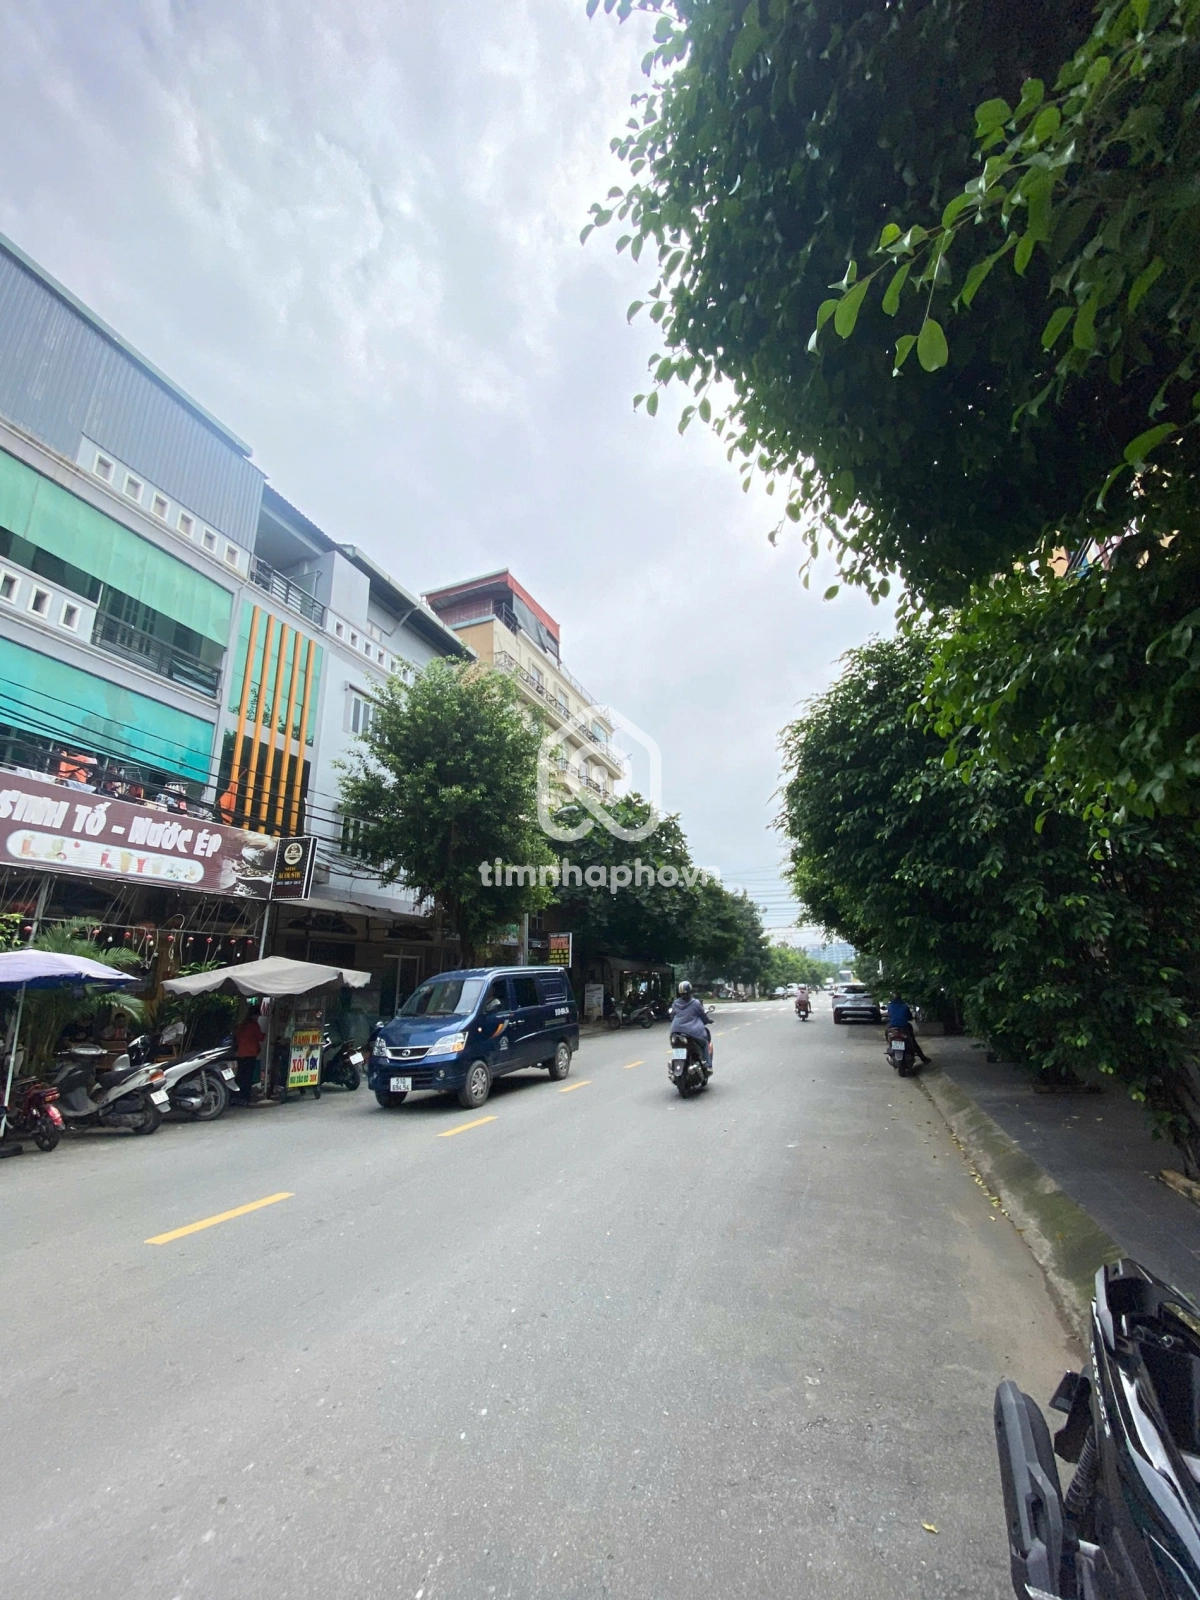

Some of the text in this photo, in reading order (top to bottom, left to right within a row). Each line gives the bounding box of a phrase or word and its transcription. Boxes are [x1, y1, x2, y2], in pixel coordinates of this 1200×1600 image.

[0, 789, 70, 829] SINH
[72, 802, 112, 836] TỐ
[111, 825, 125, 834] -
[193, 829, 222, 857] ÉP
[291, 1055, 305, 1072] XÔI
